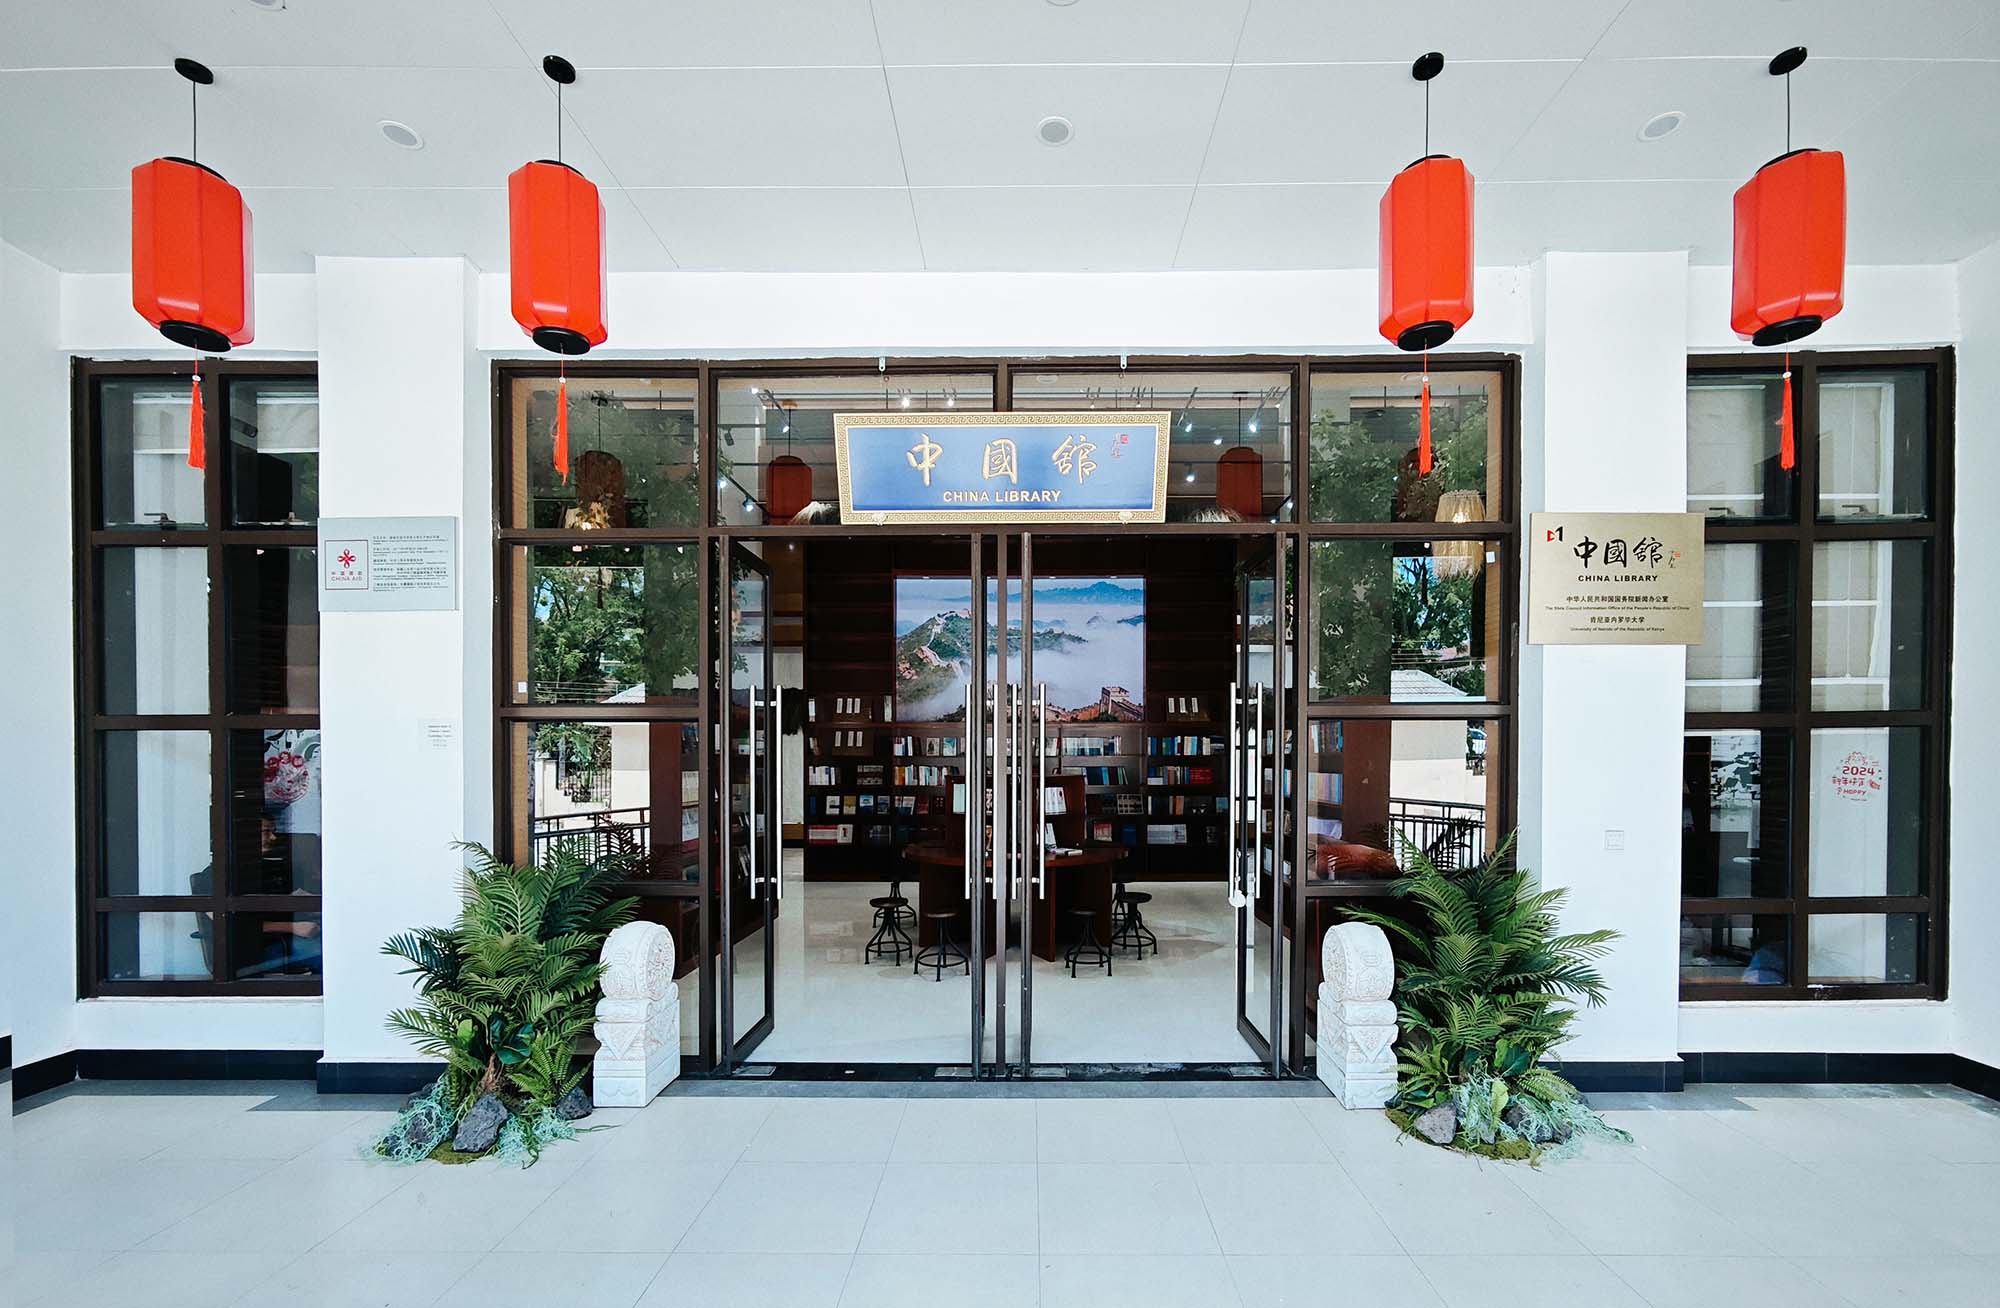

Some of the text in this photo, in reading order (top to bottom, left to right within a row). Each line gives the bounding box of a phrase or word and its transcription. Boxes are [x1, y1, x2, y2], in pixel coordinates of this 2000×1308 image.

[943, 489, 1062, 503] CHINA LIBRARY
[1842, 766, 1875, 776] 2024
